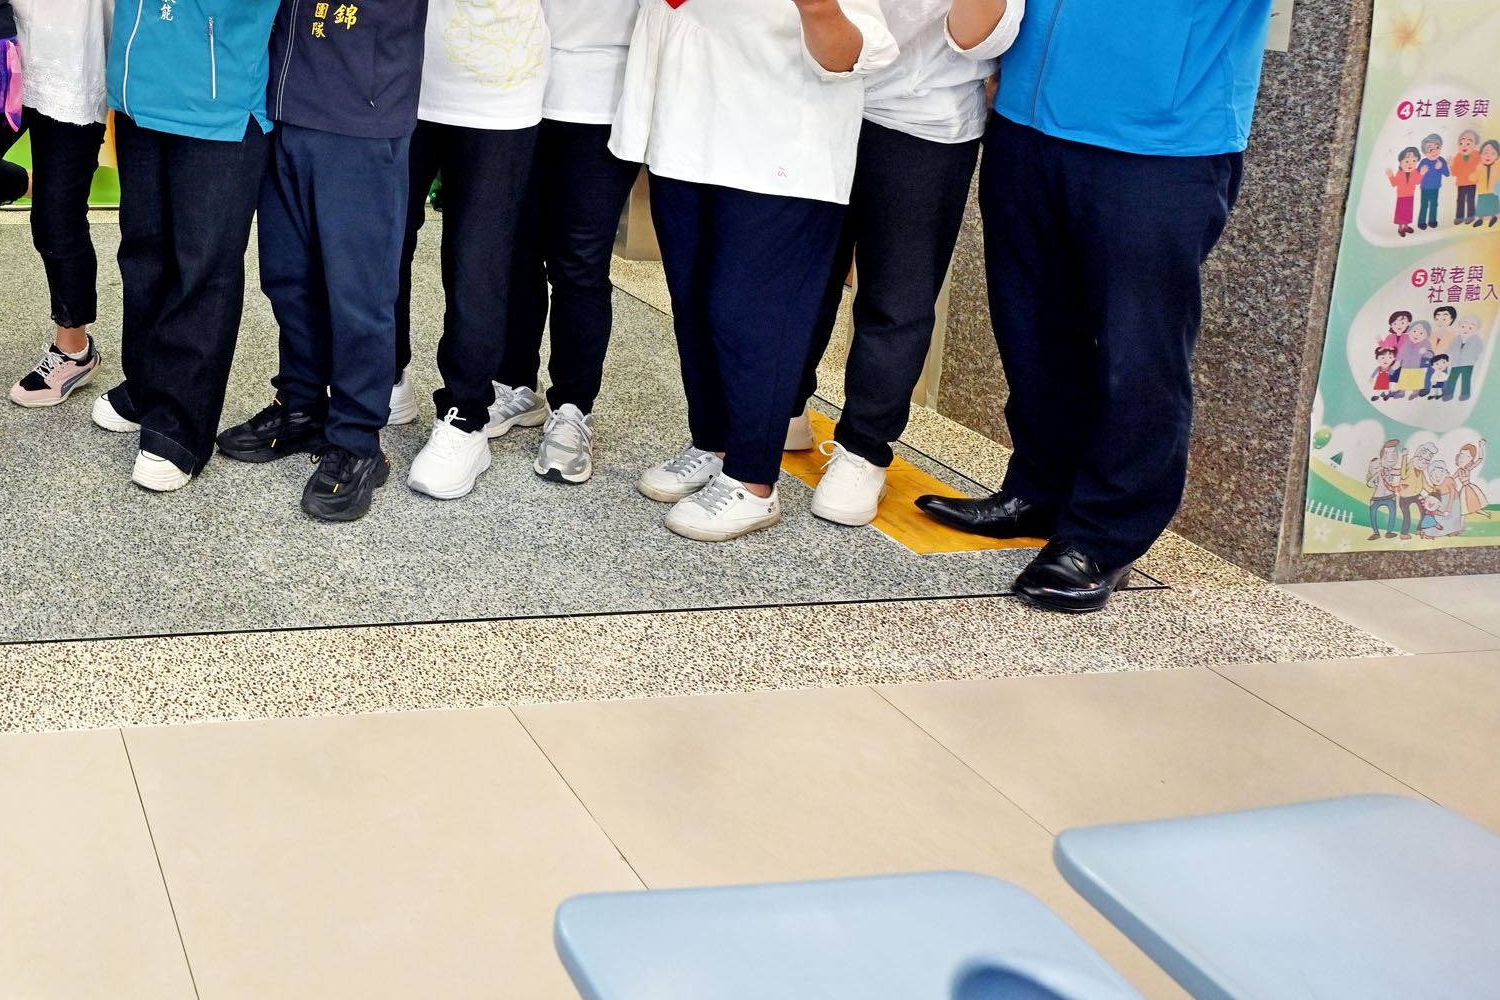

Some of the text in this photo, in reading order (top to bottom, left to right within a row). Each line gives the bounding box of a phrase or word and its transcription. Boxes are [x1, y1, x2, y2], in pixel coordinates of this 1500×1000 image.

[1415, 98, 1490, 118] 社會參與
[1430, 265, 1484, 285] 敬老與
[1427, 283, 1499, 304] 社會融入
